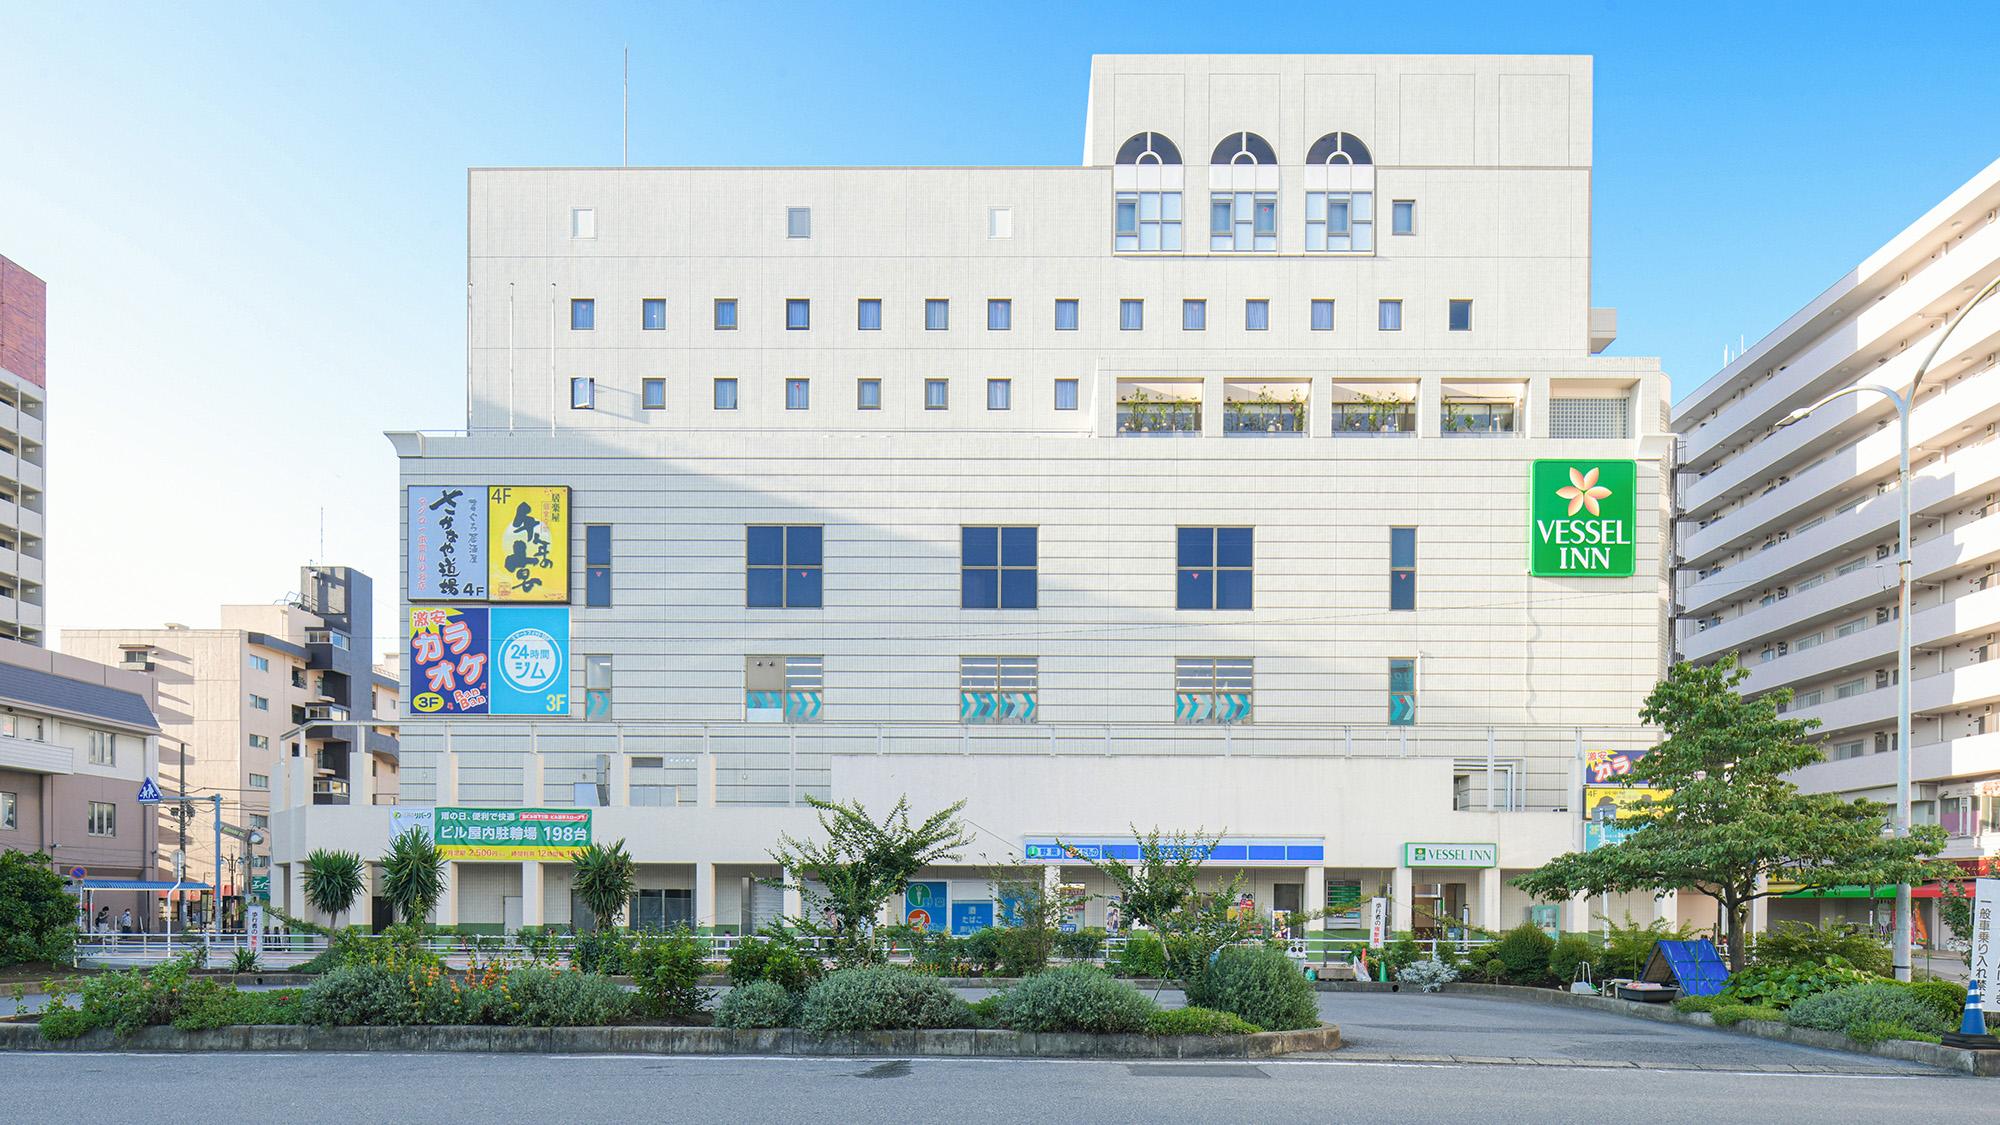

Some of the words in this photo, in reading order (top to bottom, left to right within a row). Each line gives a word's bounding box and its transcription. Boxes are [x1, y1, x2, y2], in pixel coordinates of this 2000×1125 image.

[491, 487, 512, 504] 4F
[1537, 520, 1631, 545] VESSEL
[429, 489, 463, 596] さかなや道場
[1559, 547, 1610, 569] INN
[463, 583, 484, 596] 4F
[413, 610, 446, 627] 激安
[511, 644, 550, 660] 24時間
[515, 661, 546, 679] ジム
[418, 697, 439, 708] 3F
[454, 688, 480, 704] Ban
[460, 696, 486, 711] Ban
[546, 694, 567, 712] 3F
[441, 811, 515, 821] 雨の日、便利で快適
[441, 826, 537, 840] ビル屋内駐輪場
[543, 826, 587, 842] 198台
[1428, 849, 1466, 861] VESSEL
[1470, 849, 1491, 861] INN
